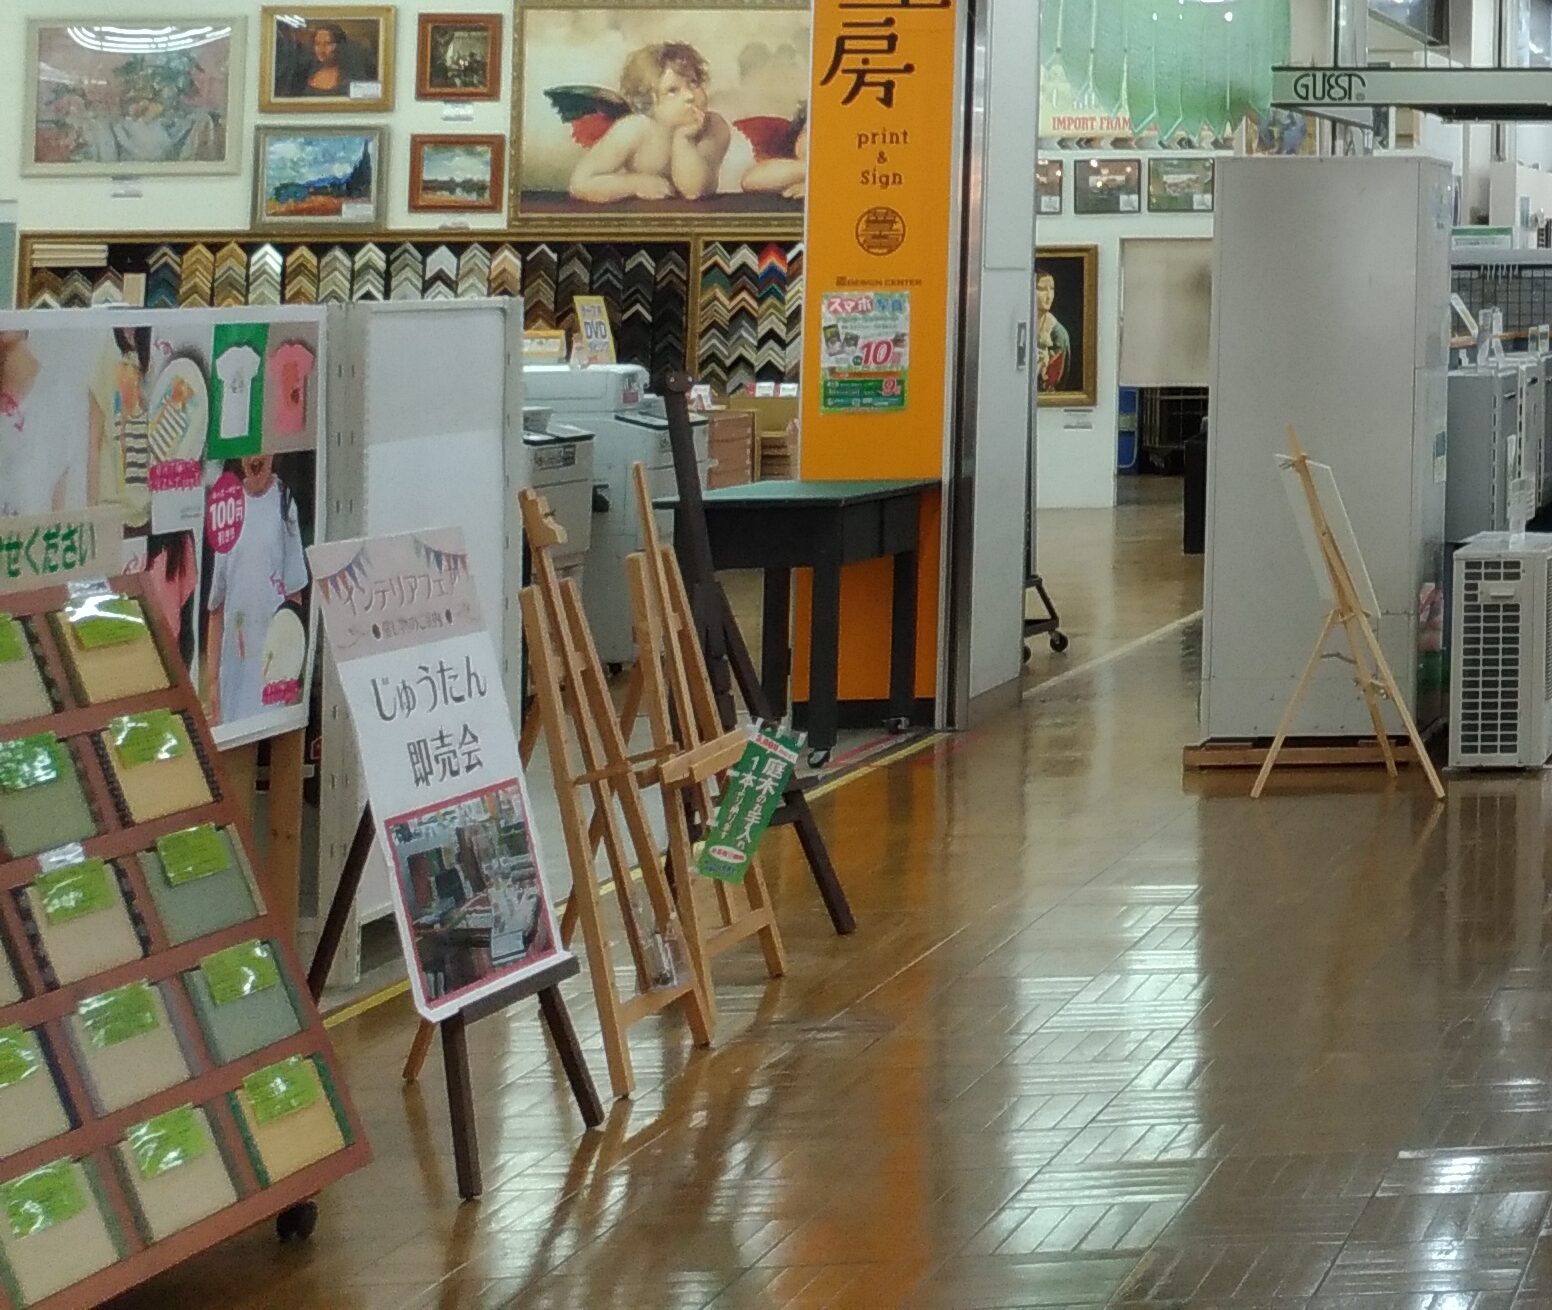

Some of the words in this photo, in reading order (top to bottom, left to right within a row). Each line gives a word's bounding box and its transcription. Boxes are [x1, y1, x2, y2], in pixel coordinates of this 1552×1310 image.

[1293, 72, 1367, 101] GUEST
[1052, 116, 1097, 131] IMPORT
[1099, 117, 1132, 132] FRAM
[856, 126, 909, 149] print
[876, 150, 888, 165] &
[828, 297, 872, 312] スマホ
[583, 320, 608, 340] DVD
[370, 655, 488, 722] じゅうたん
[406, 722, 484, 787] 即売会
